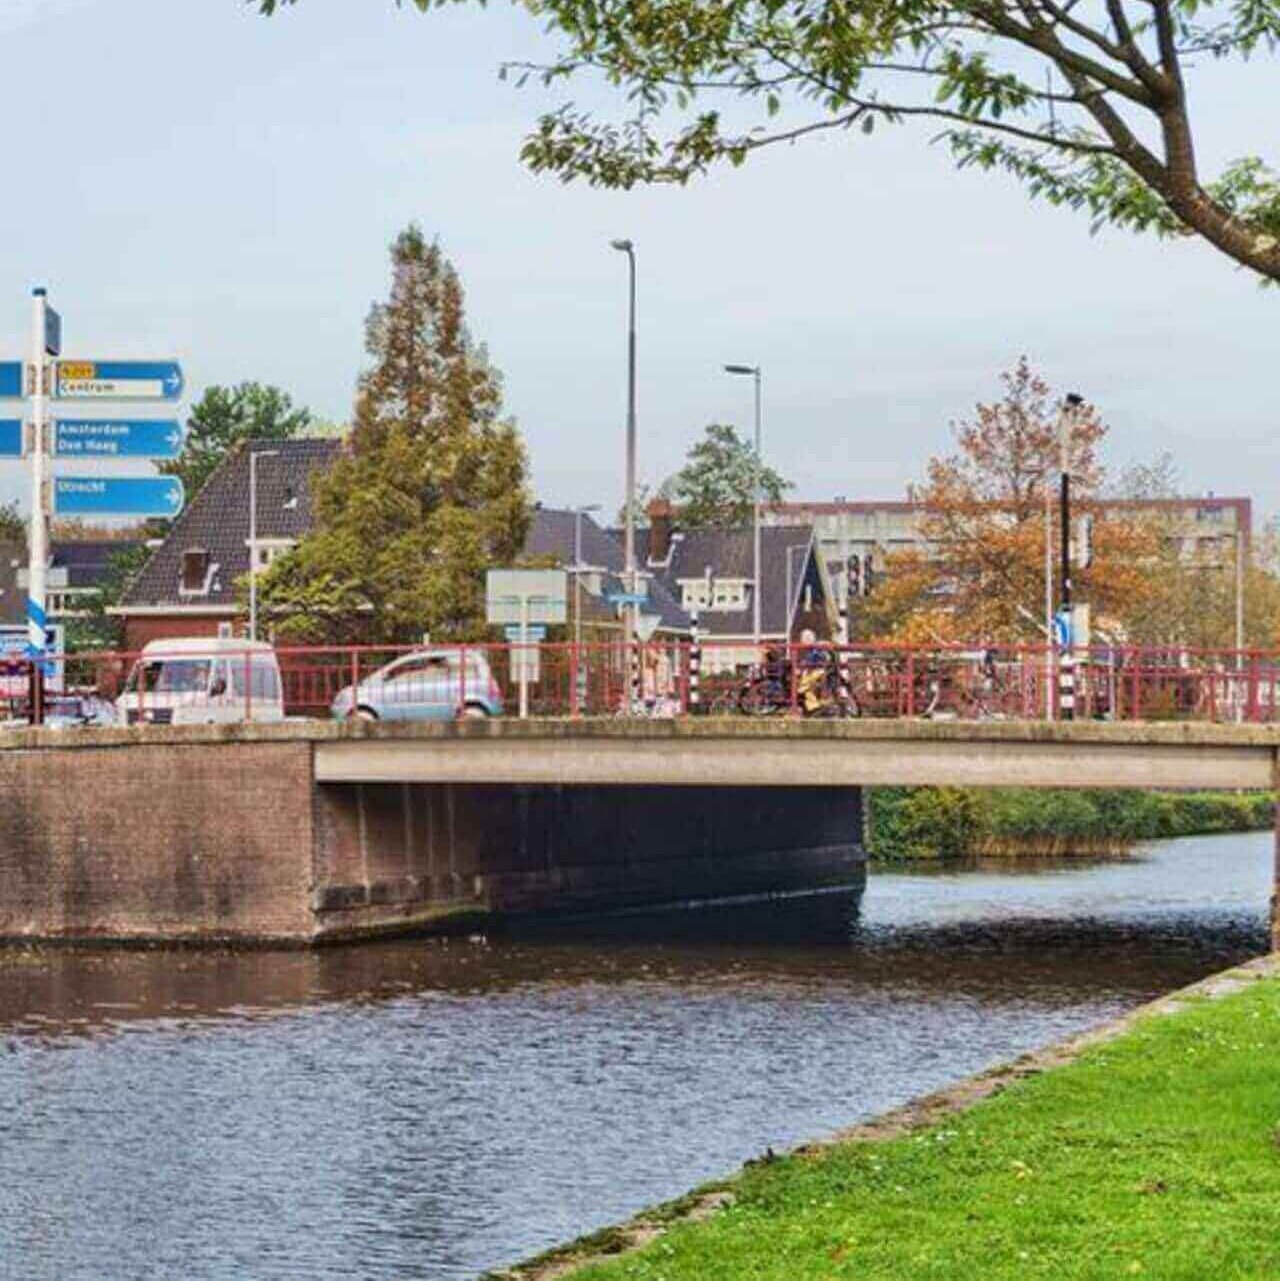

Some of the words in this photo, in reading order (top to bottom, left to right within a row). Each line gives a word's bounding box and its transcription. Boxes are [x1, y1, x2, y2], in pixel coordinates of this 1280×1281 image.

[60, 381, 115, 393] Centrum
[59, 423, 130, 435] Amsterdam
[59, 440, 82, 451] Den
[85, 440, 118, 453] Haag
[59, 480, 107, 493] Utrecht
